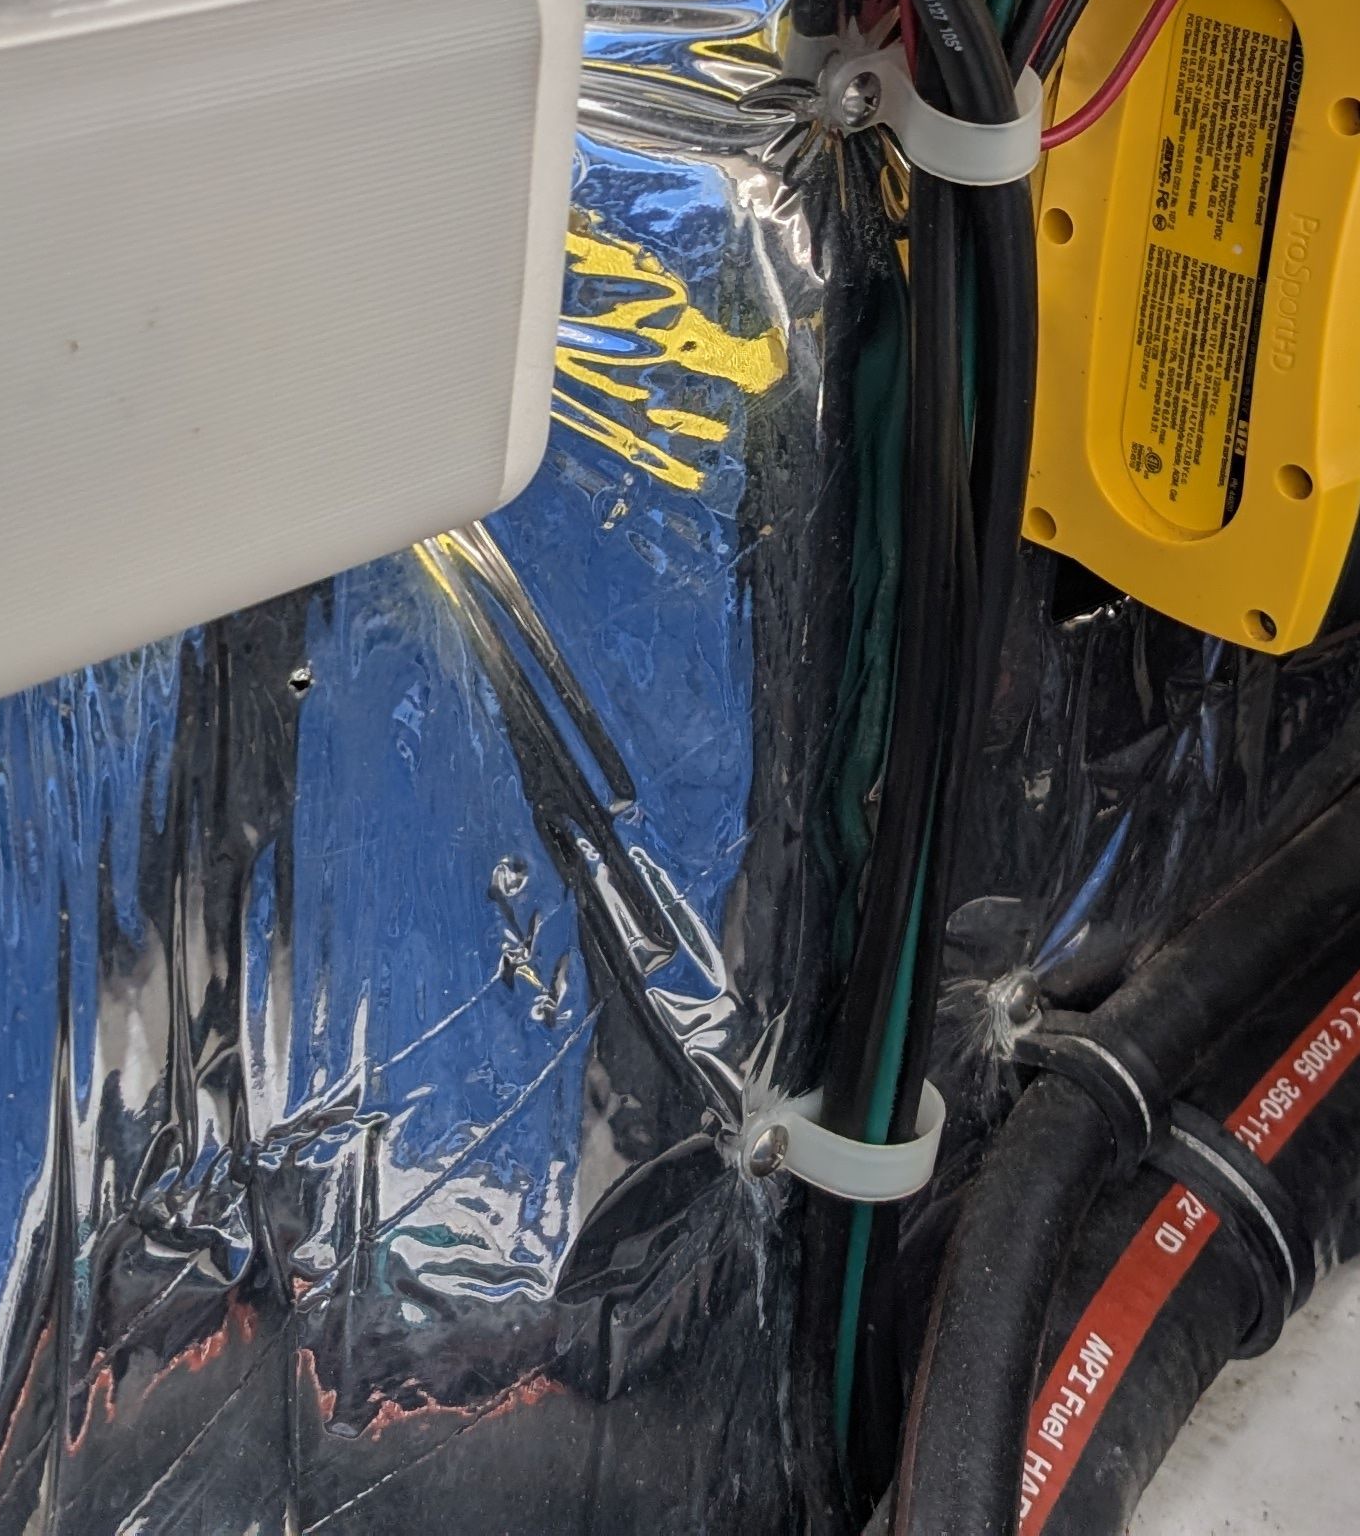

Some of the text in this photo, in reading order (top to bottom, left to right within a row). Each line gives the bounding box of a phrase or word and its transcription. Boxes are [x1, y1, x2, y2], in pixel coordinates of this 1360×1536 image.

[1270, 212, 1321, 375] ProSportHD
[1293, 1030, 1341, 1082] 2005
[1154, 1221, 1186, 1254] ID
[1068, 1332, 1114, 1394] MPI
[1038, 1385, 1086, 1451] Fuel
